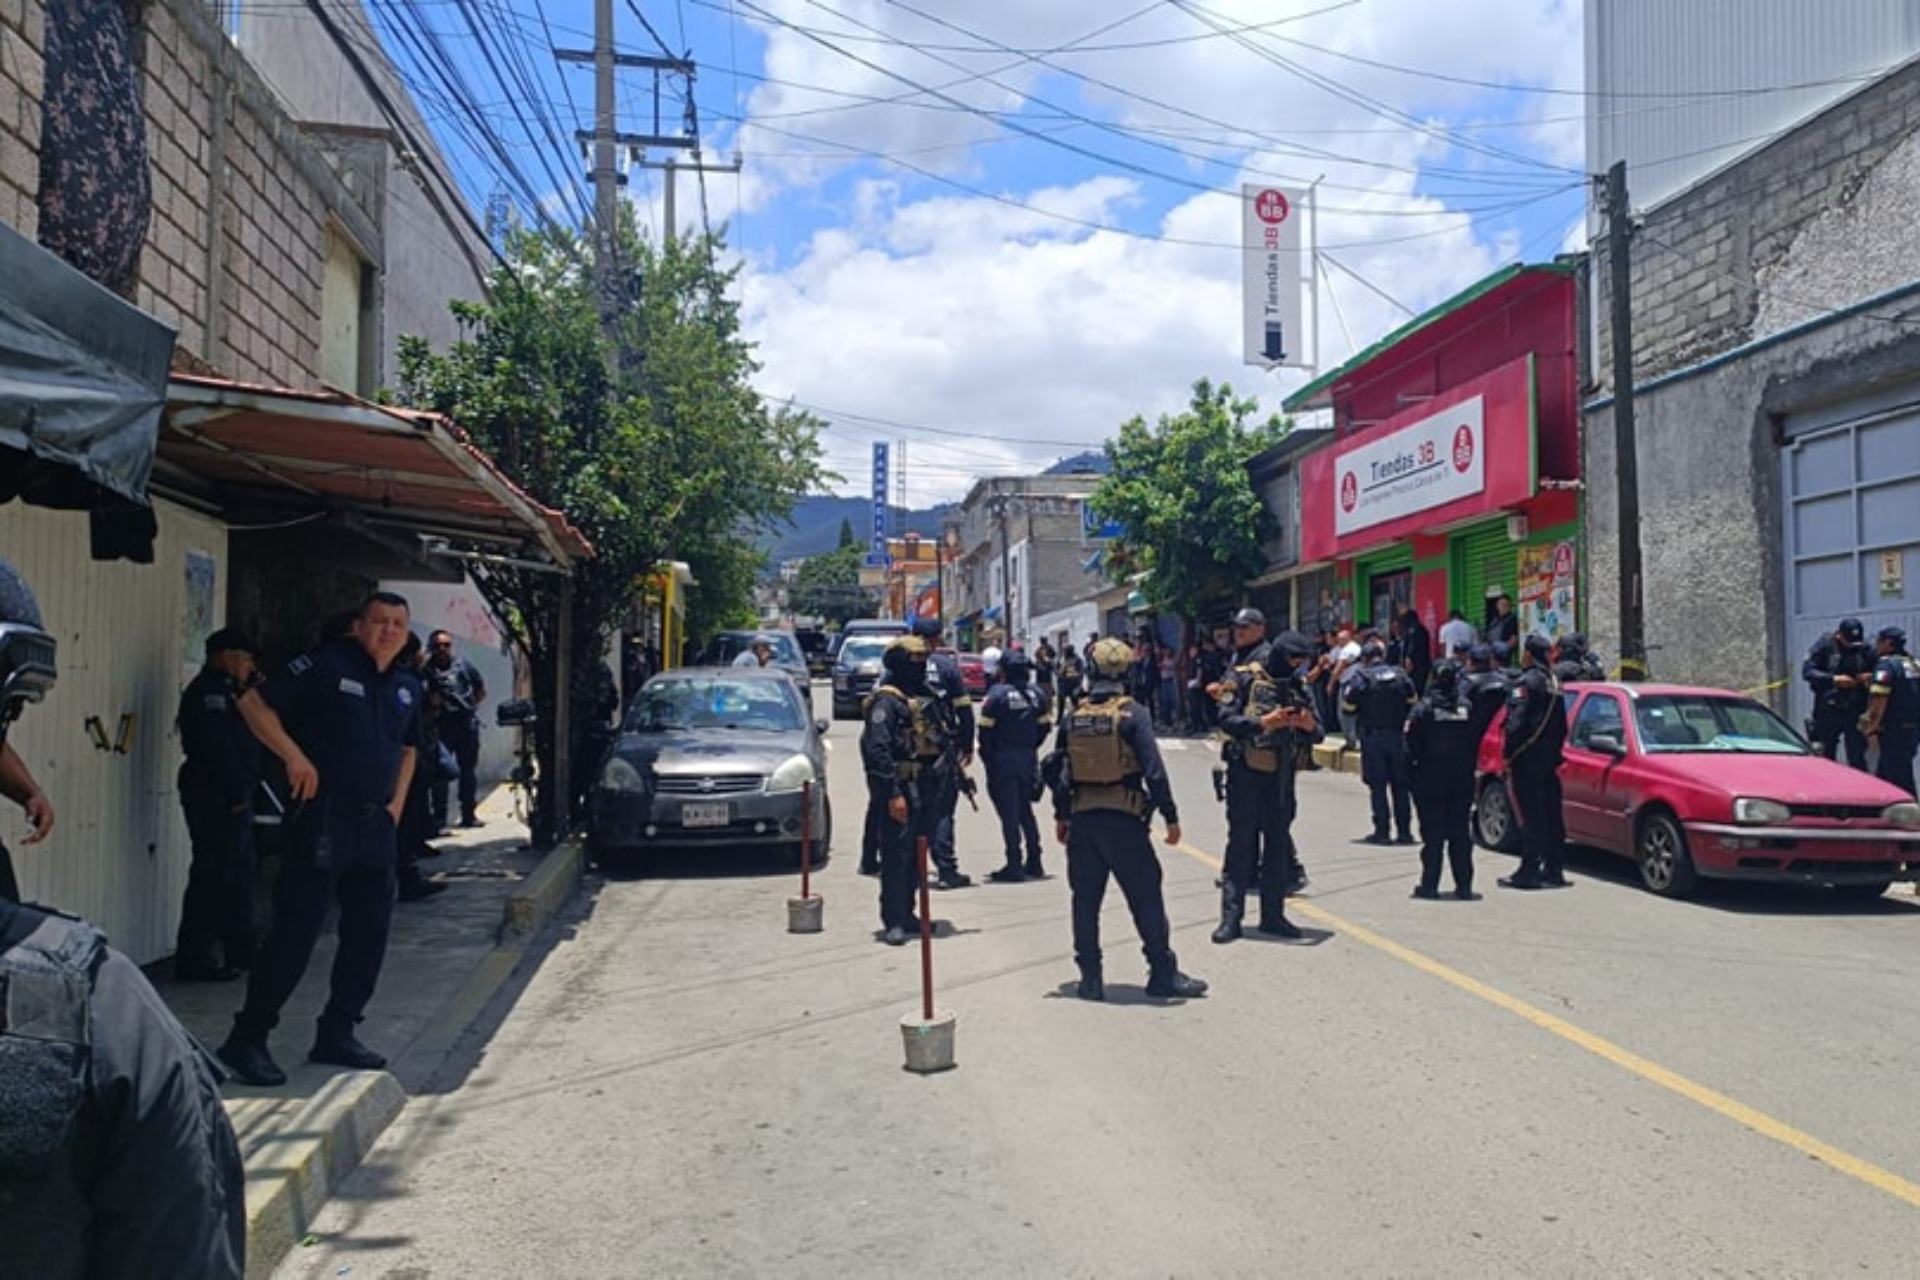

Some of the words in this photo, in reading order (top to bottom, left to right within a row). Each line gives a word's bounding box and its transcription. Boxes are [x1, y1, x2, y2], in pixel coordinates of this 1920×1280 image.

[1265, 227, 1278, 250] 3B
[1265, 253, 1278, 315] Tiendas
[1371, 453, 1414, 481] Tiendas
[1419, 440, 1434, 464] 3B
